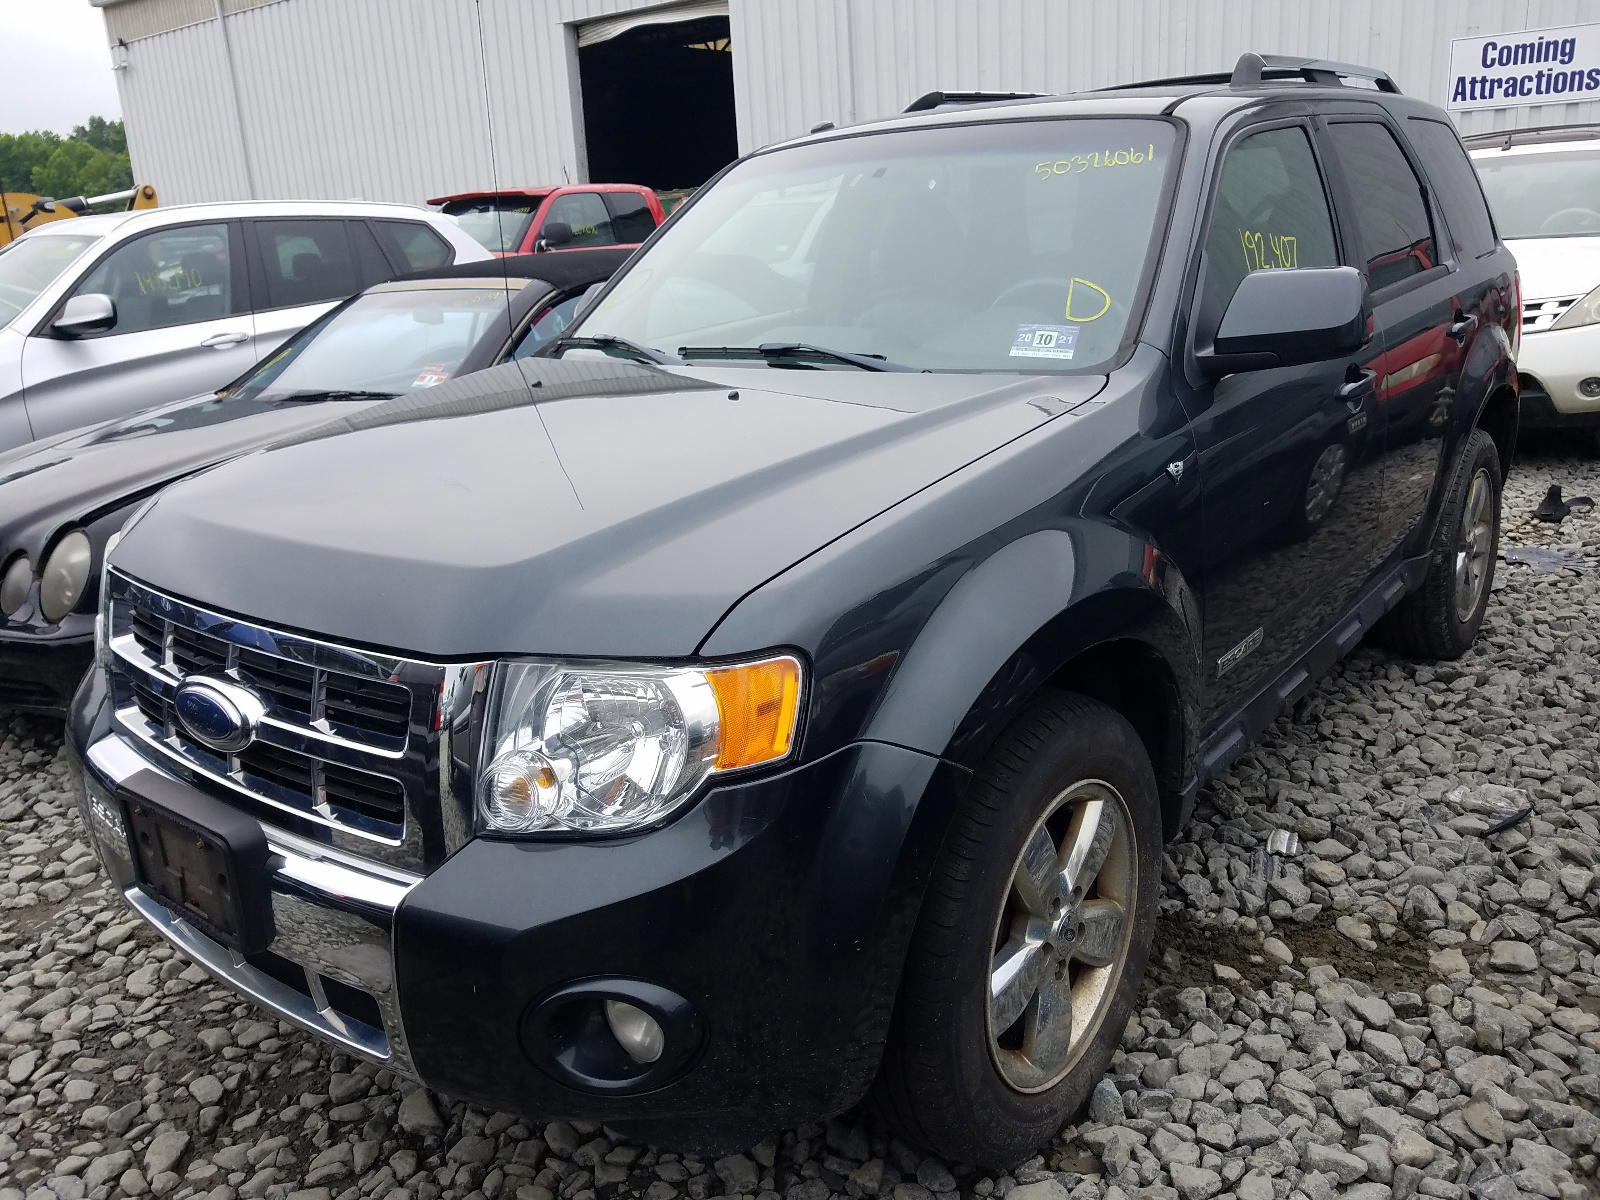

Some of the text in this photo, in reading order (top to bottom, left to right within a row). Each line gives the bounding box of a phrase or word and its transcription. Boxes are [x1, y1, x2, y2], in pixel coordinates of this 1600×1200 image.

[1481, 36, 1577, 69] Coming
[1451, 68, 1600, 102] Attractions
[1034, 143, 1154, 181] 50326061
[1065, 277, 1111, 322] D
[1018, 334, 1073, 346] 20 10 21
